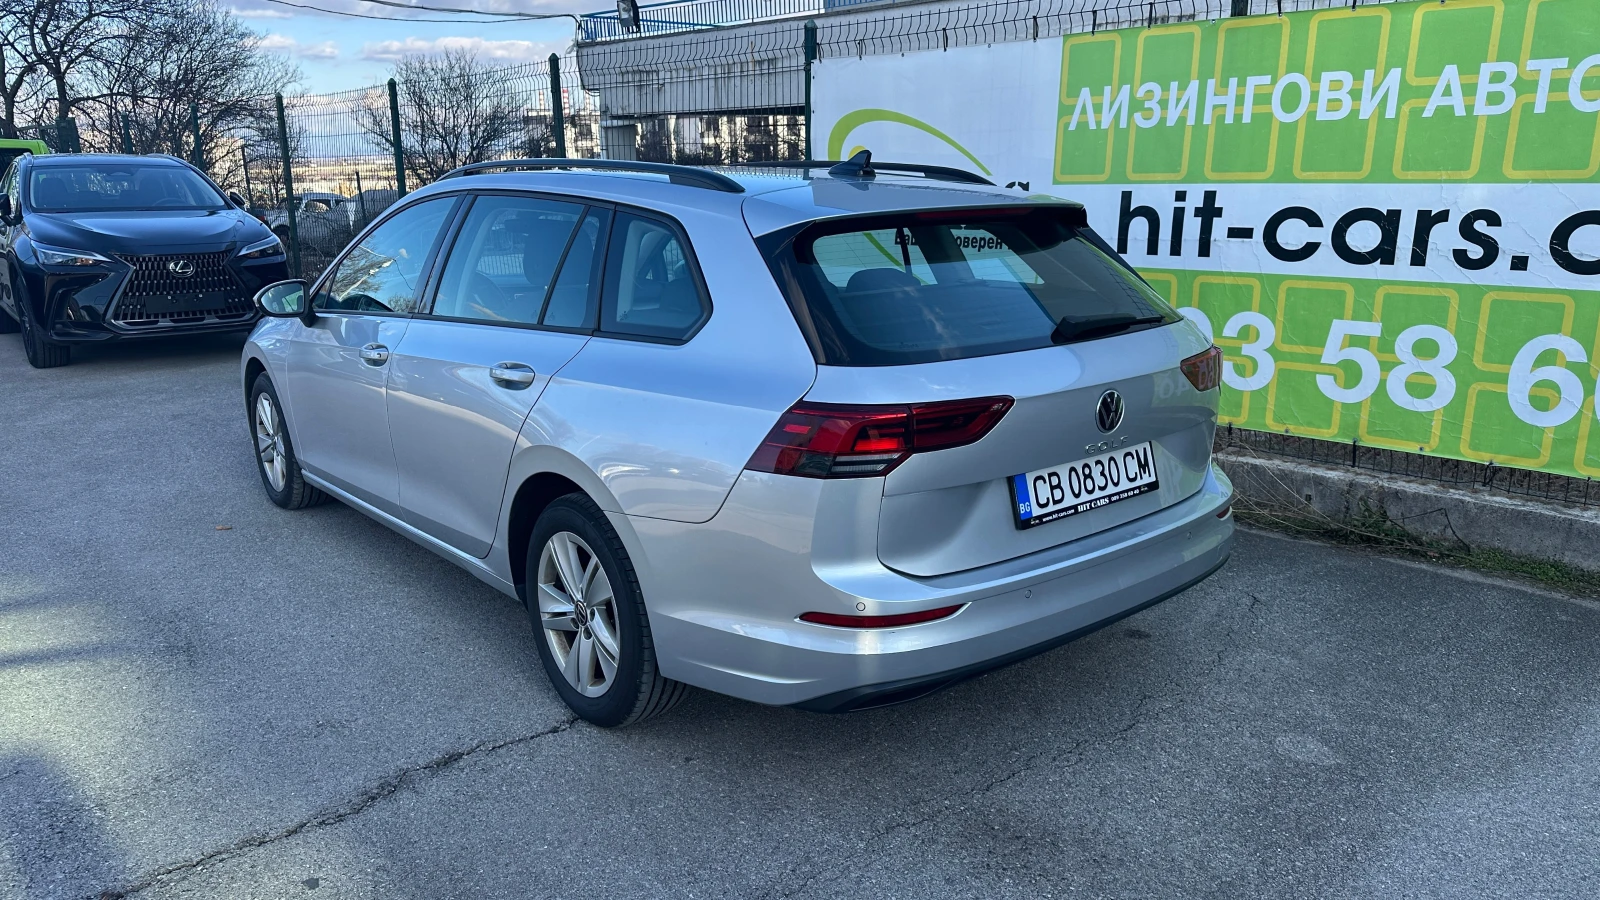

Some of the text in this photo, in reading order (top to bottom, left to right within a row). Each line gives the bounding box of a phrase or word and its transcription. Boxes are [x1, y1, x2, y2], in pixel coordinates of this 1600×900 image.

[1068, 53, 1600, 130] ЛИЗИНГОВИ АВТО
[1316, 319, 1458, 412] 58
[1507, 333, 1600, 427] 6
[1085, 436, 1128, 454] GOLF
[1032, 447, 1151, 509] CB 0830 CM
[1019, 503, 1031, 514] BG
[1077, 502, 1090, 512] HIT
[1091, 497, 1109, 508] CARS
